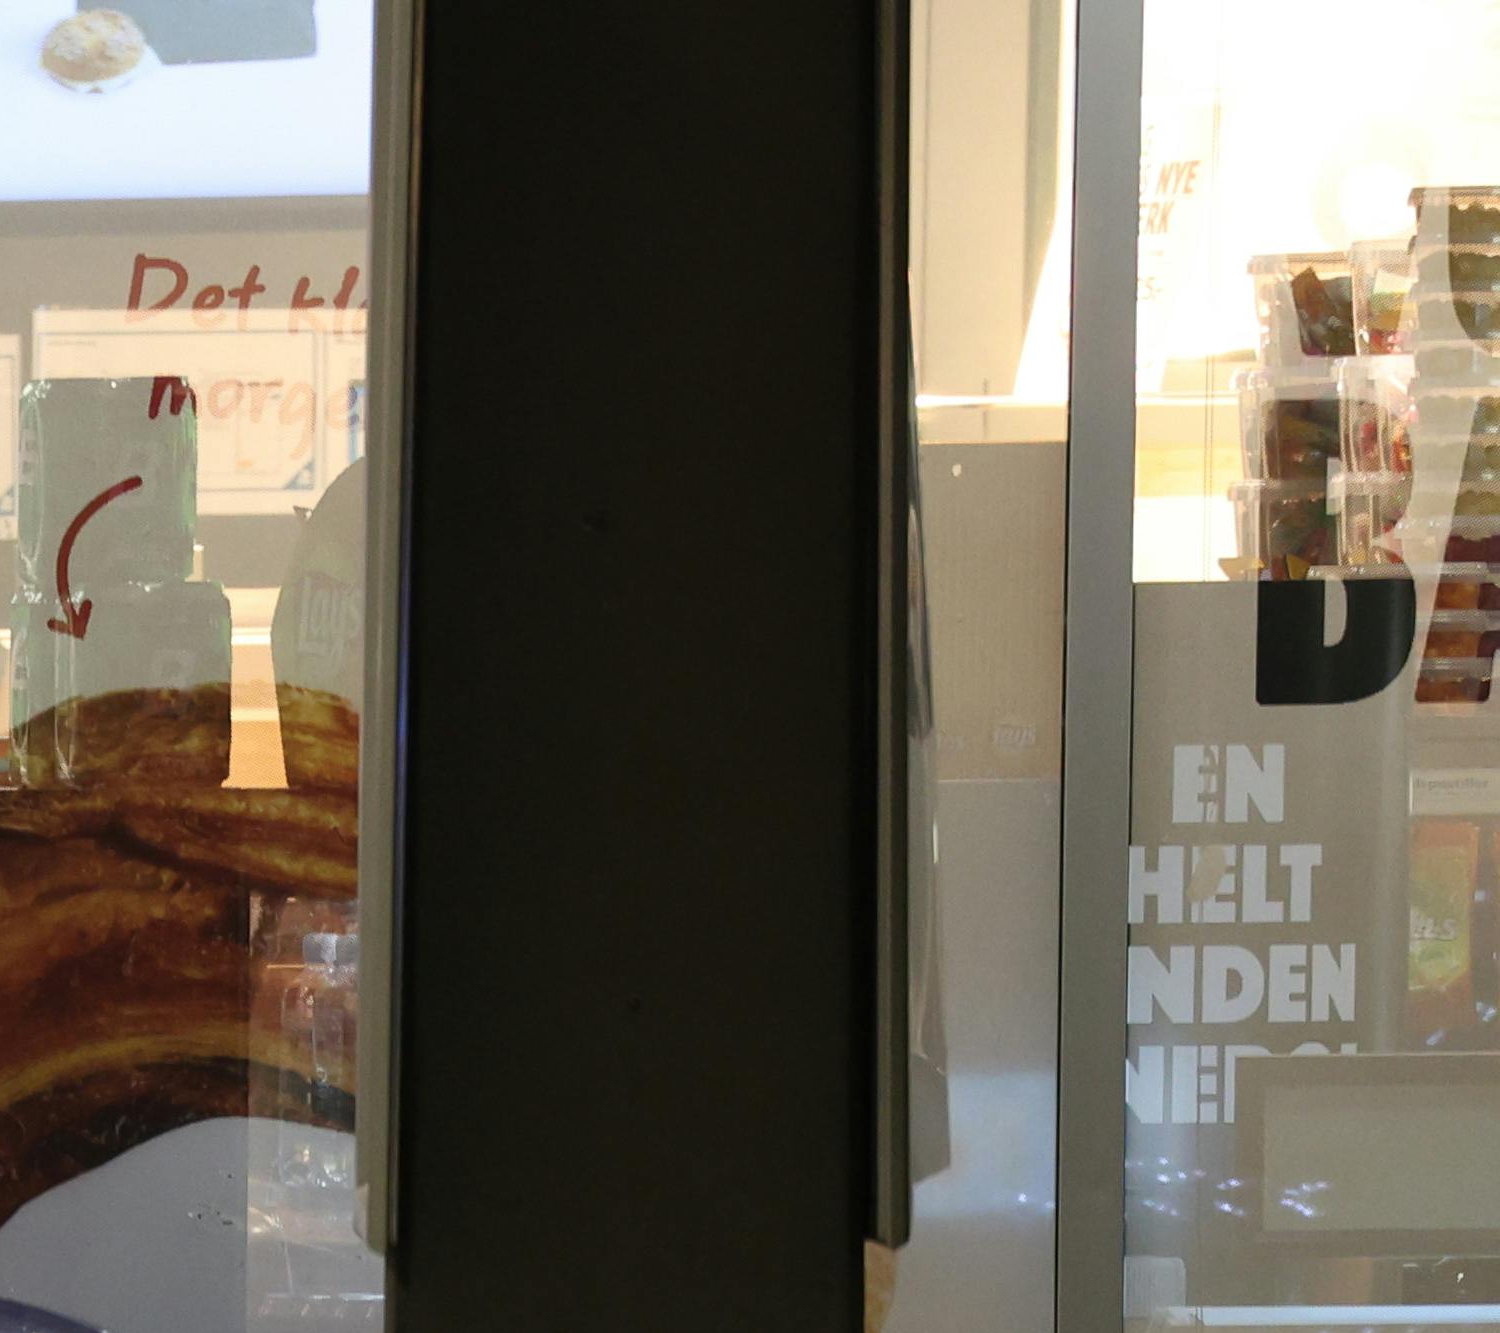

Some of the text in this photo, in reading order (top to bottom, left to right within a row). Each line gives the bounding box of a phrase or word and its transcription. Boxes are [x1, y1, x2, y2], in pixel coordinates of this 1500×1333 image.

[124, 252, 368, 336] Det kl
[1171, 742, 1285, 824] EN
[1127, 843, 1323, 925] HELT
